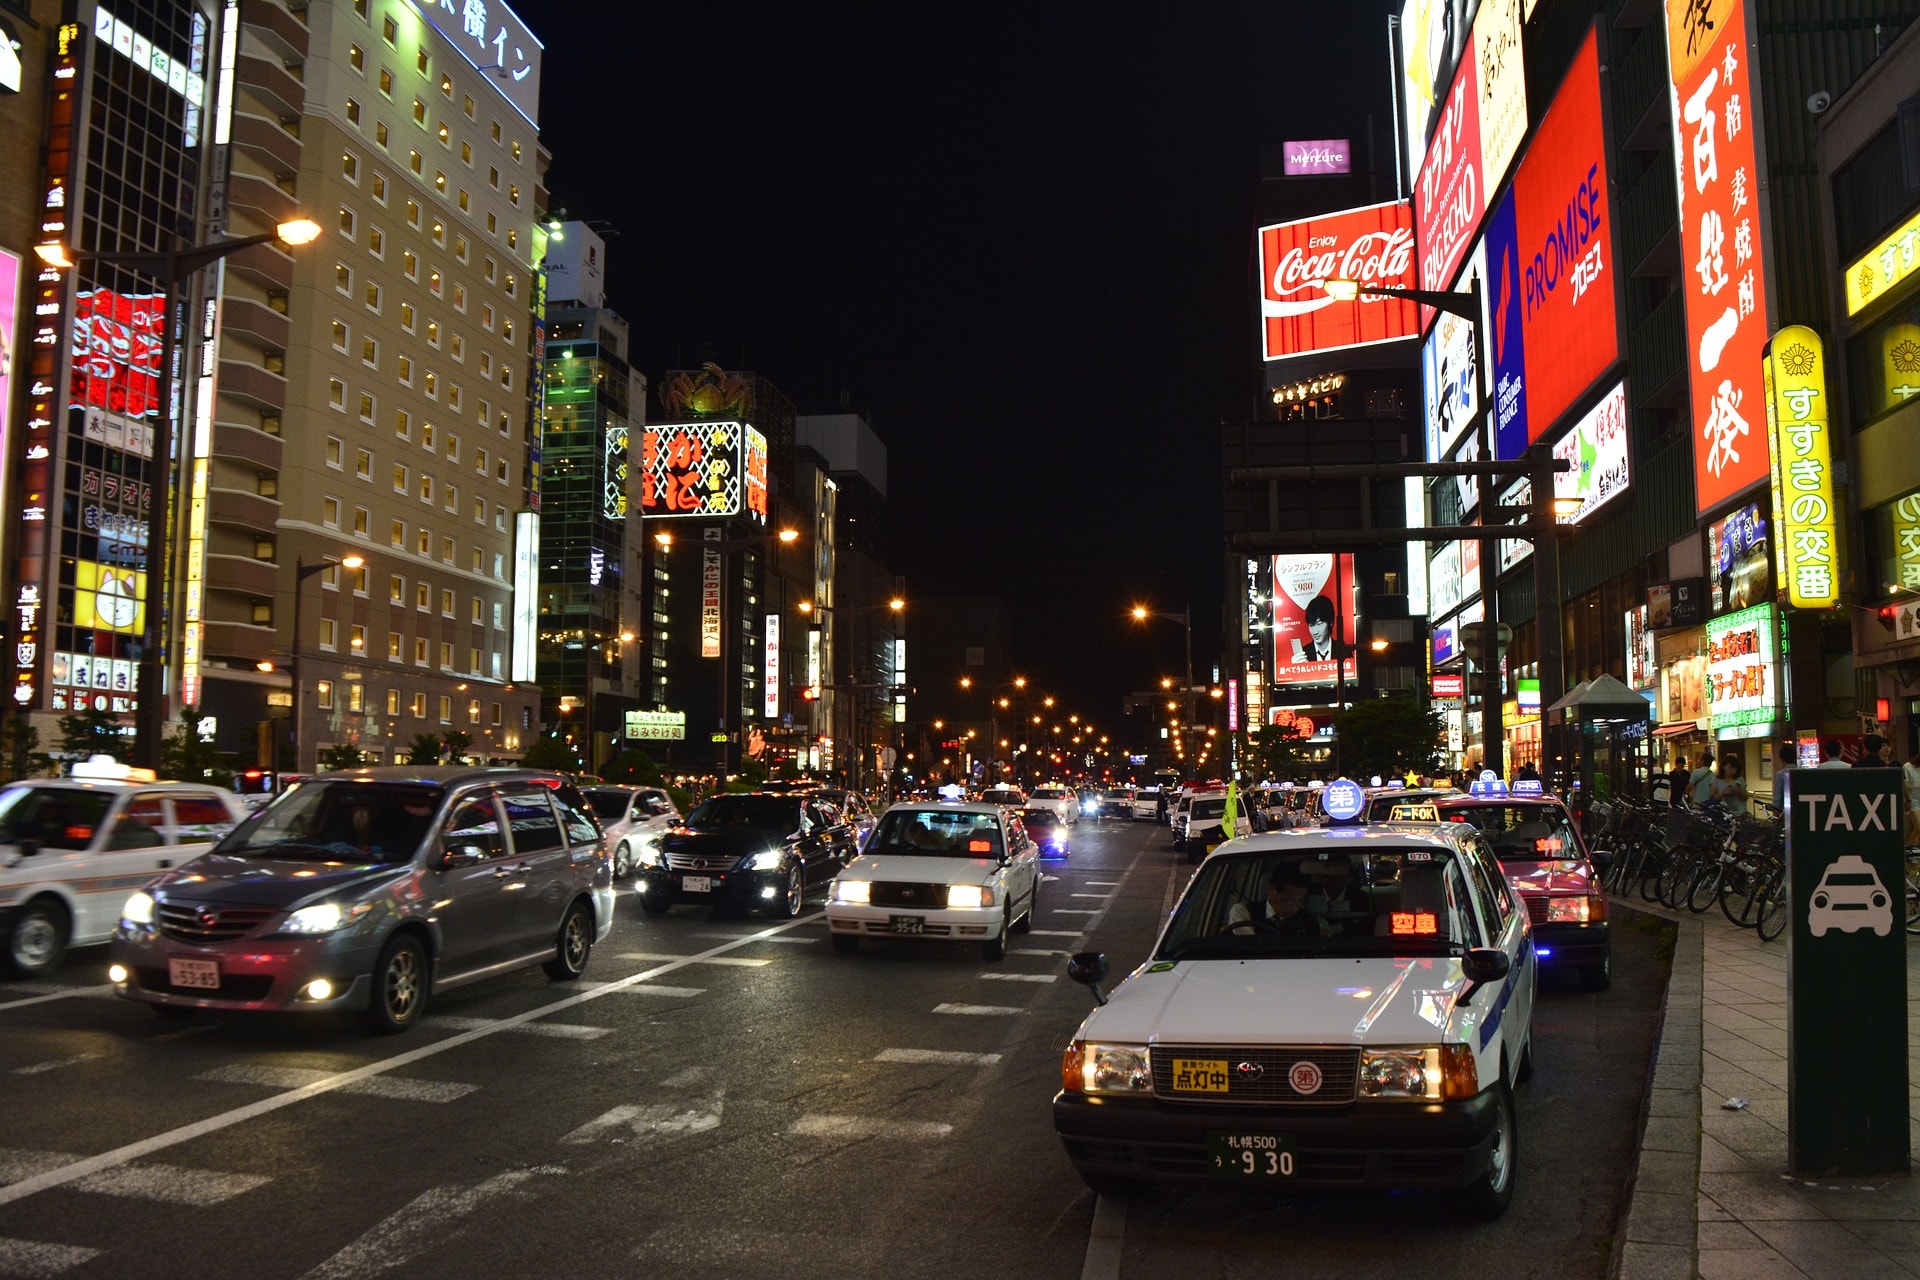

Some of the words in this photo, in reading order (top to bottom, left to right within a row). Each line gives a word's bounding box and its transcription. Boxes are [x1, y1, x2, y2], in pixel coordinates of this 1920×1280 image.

[1722, 43, 1742, 142] 本格
[1290, 152, 1343, 164] Mercure
[1423, 75, 1466, 223] カラオケ
[1443, 162, 1475, 254] ECHO
[1273, 227, 1415, 296] Coca-Cola
[1309, 234, 1338, 249] Enjoy
[1524, 162, 1601, 322] PROMISE
[1730, 167, 1755, 322] 麦焼酎
[1571, 239, 1604, 306] プロミス
[1684, 67, 1749, 479] 百姓一揆
[1498, 372, 1509, 398] SMBC
[1499, 398, 1518, 431] FINANCE
[1783, 386, 1832, 600] すすきの交番
[703, 530, 719, 642] よこそかにの王国北海道へ
[1279, 661, 1352, 676] 選べてうれしいドコモの金
[629, 726, 682, 739] おみやげ処
[1393, 807, 1434, 821] カードOK
[1798, 794, 1898, 832] TAXI
[1391, 912, 1437, 934] 空車
[1176, 1069, 1226, 1090] 点灯中
